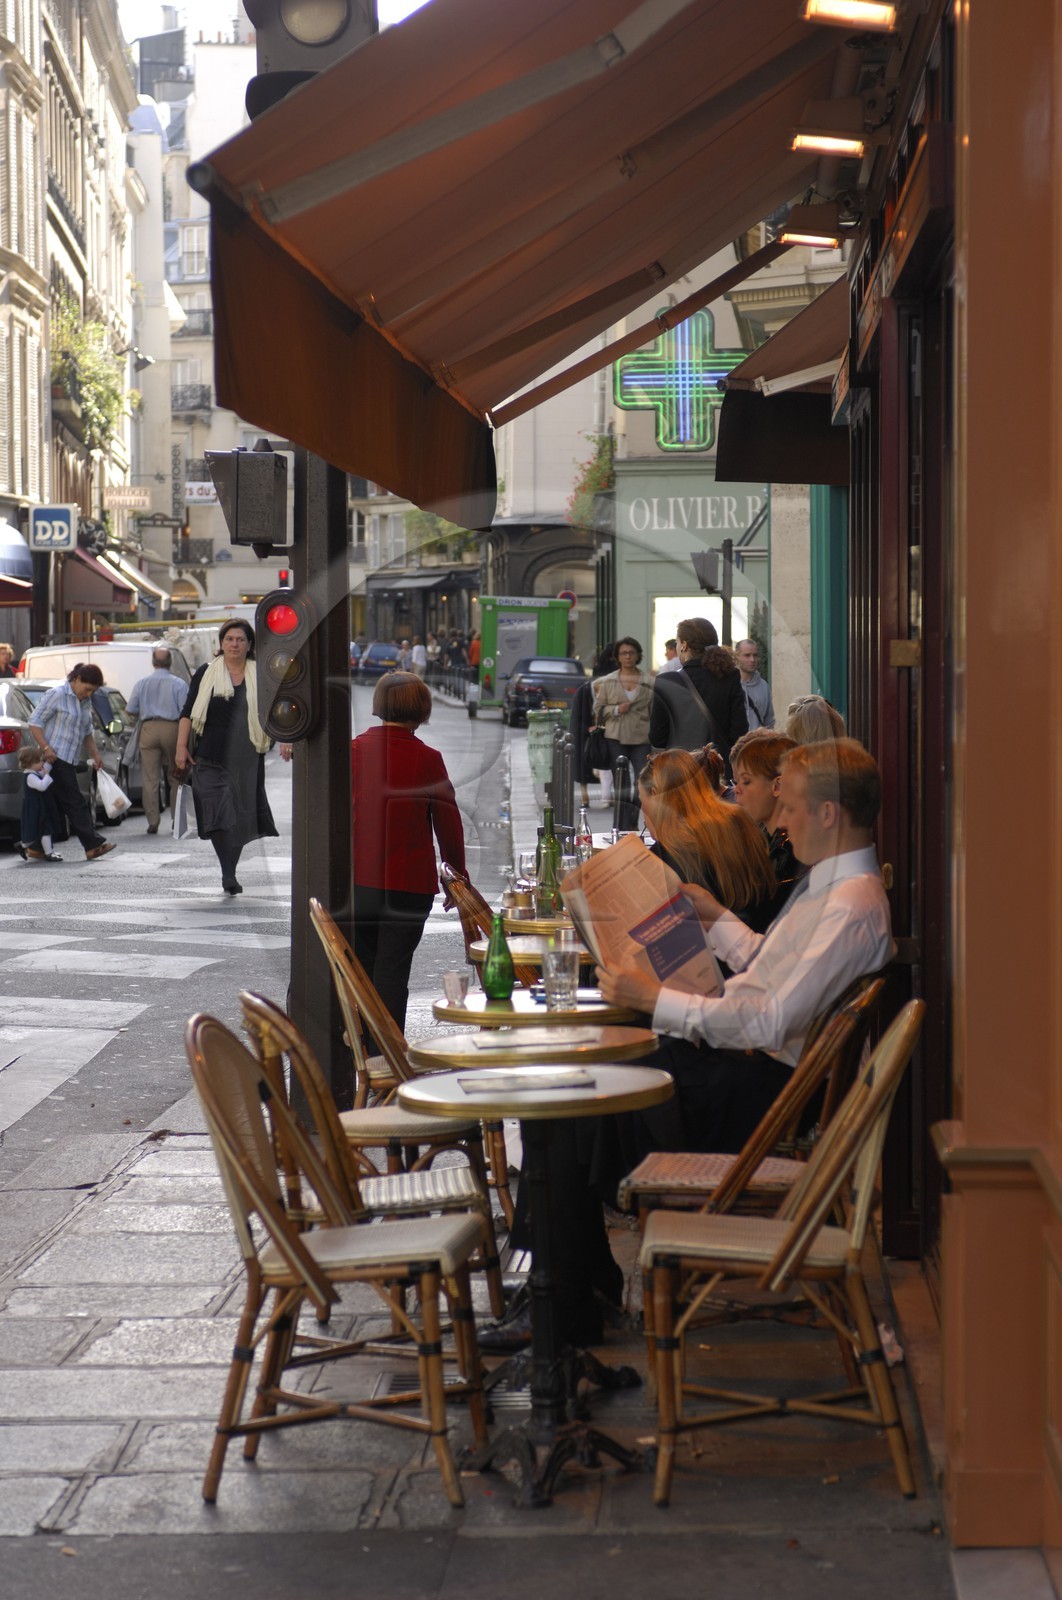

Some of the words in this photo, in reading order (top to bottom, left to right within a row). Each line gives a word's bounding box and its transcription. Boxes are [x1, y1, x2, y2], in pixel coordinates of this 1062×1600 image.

[105, 487, 149, 497] HORLOGER
[197, 485, 211, 496] du
[172, 484, 184, 516] ligne
[35, 520, 69, 540] DD
